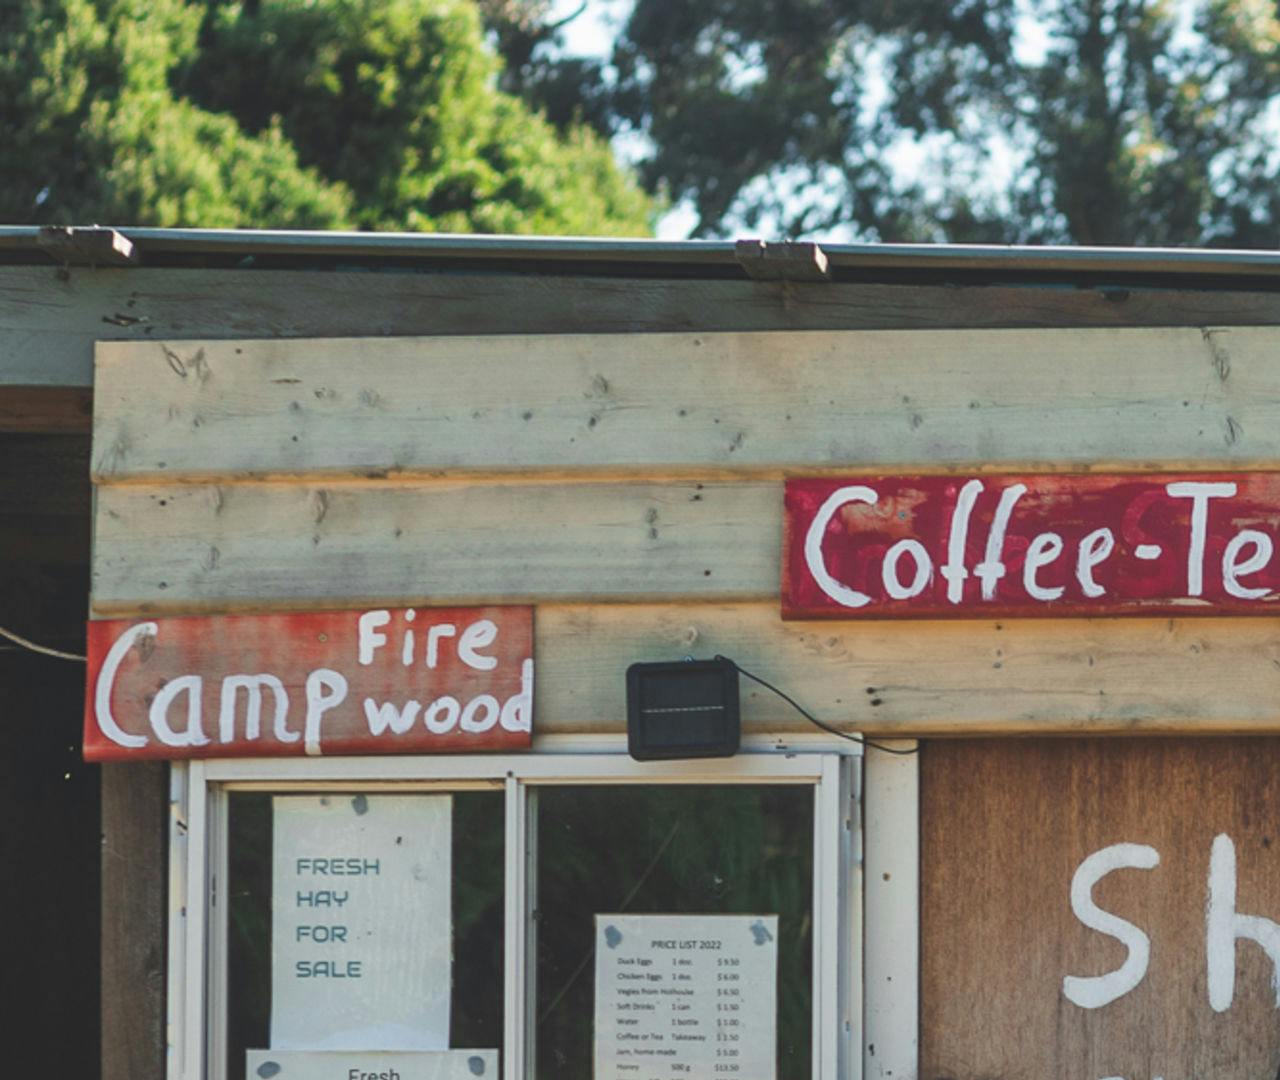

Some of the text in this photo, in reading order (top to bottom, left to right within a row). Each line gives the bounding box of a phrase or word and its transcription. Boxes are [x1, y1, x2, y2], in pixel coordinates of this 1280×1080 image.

[358, 608, 498, 670] Fire
[95, 622, 349, 755] Camp
[364, 658, 534, 736] wood
[297, 858, 380, 875] FRESH
[297, 891, 348, 907] HAY
[296, 925, 347, 943] FOR
[651, 939, 722, 951] PRICE LIST 2022
[296, 961, 361, 978] SALE
[637, 957, 652, 967] Eggs
[617, 972, 645, 981] Chicken
[646, 972, 662, 982] Eggs
[616, 1032, 640, 1041] Coffee
[616, 1063, 639, 1072] Honey
